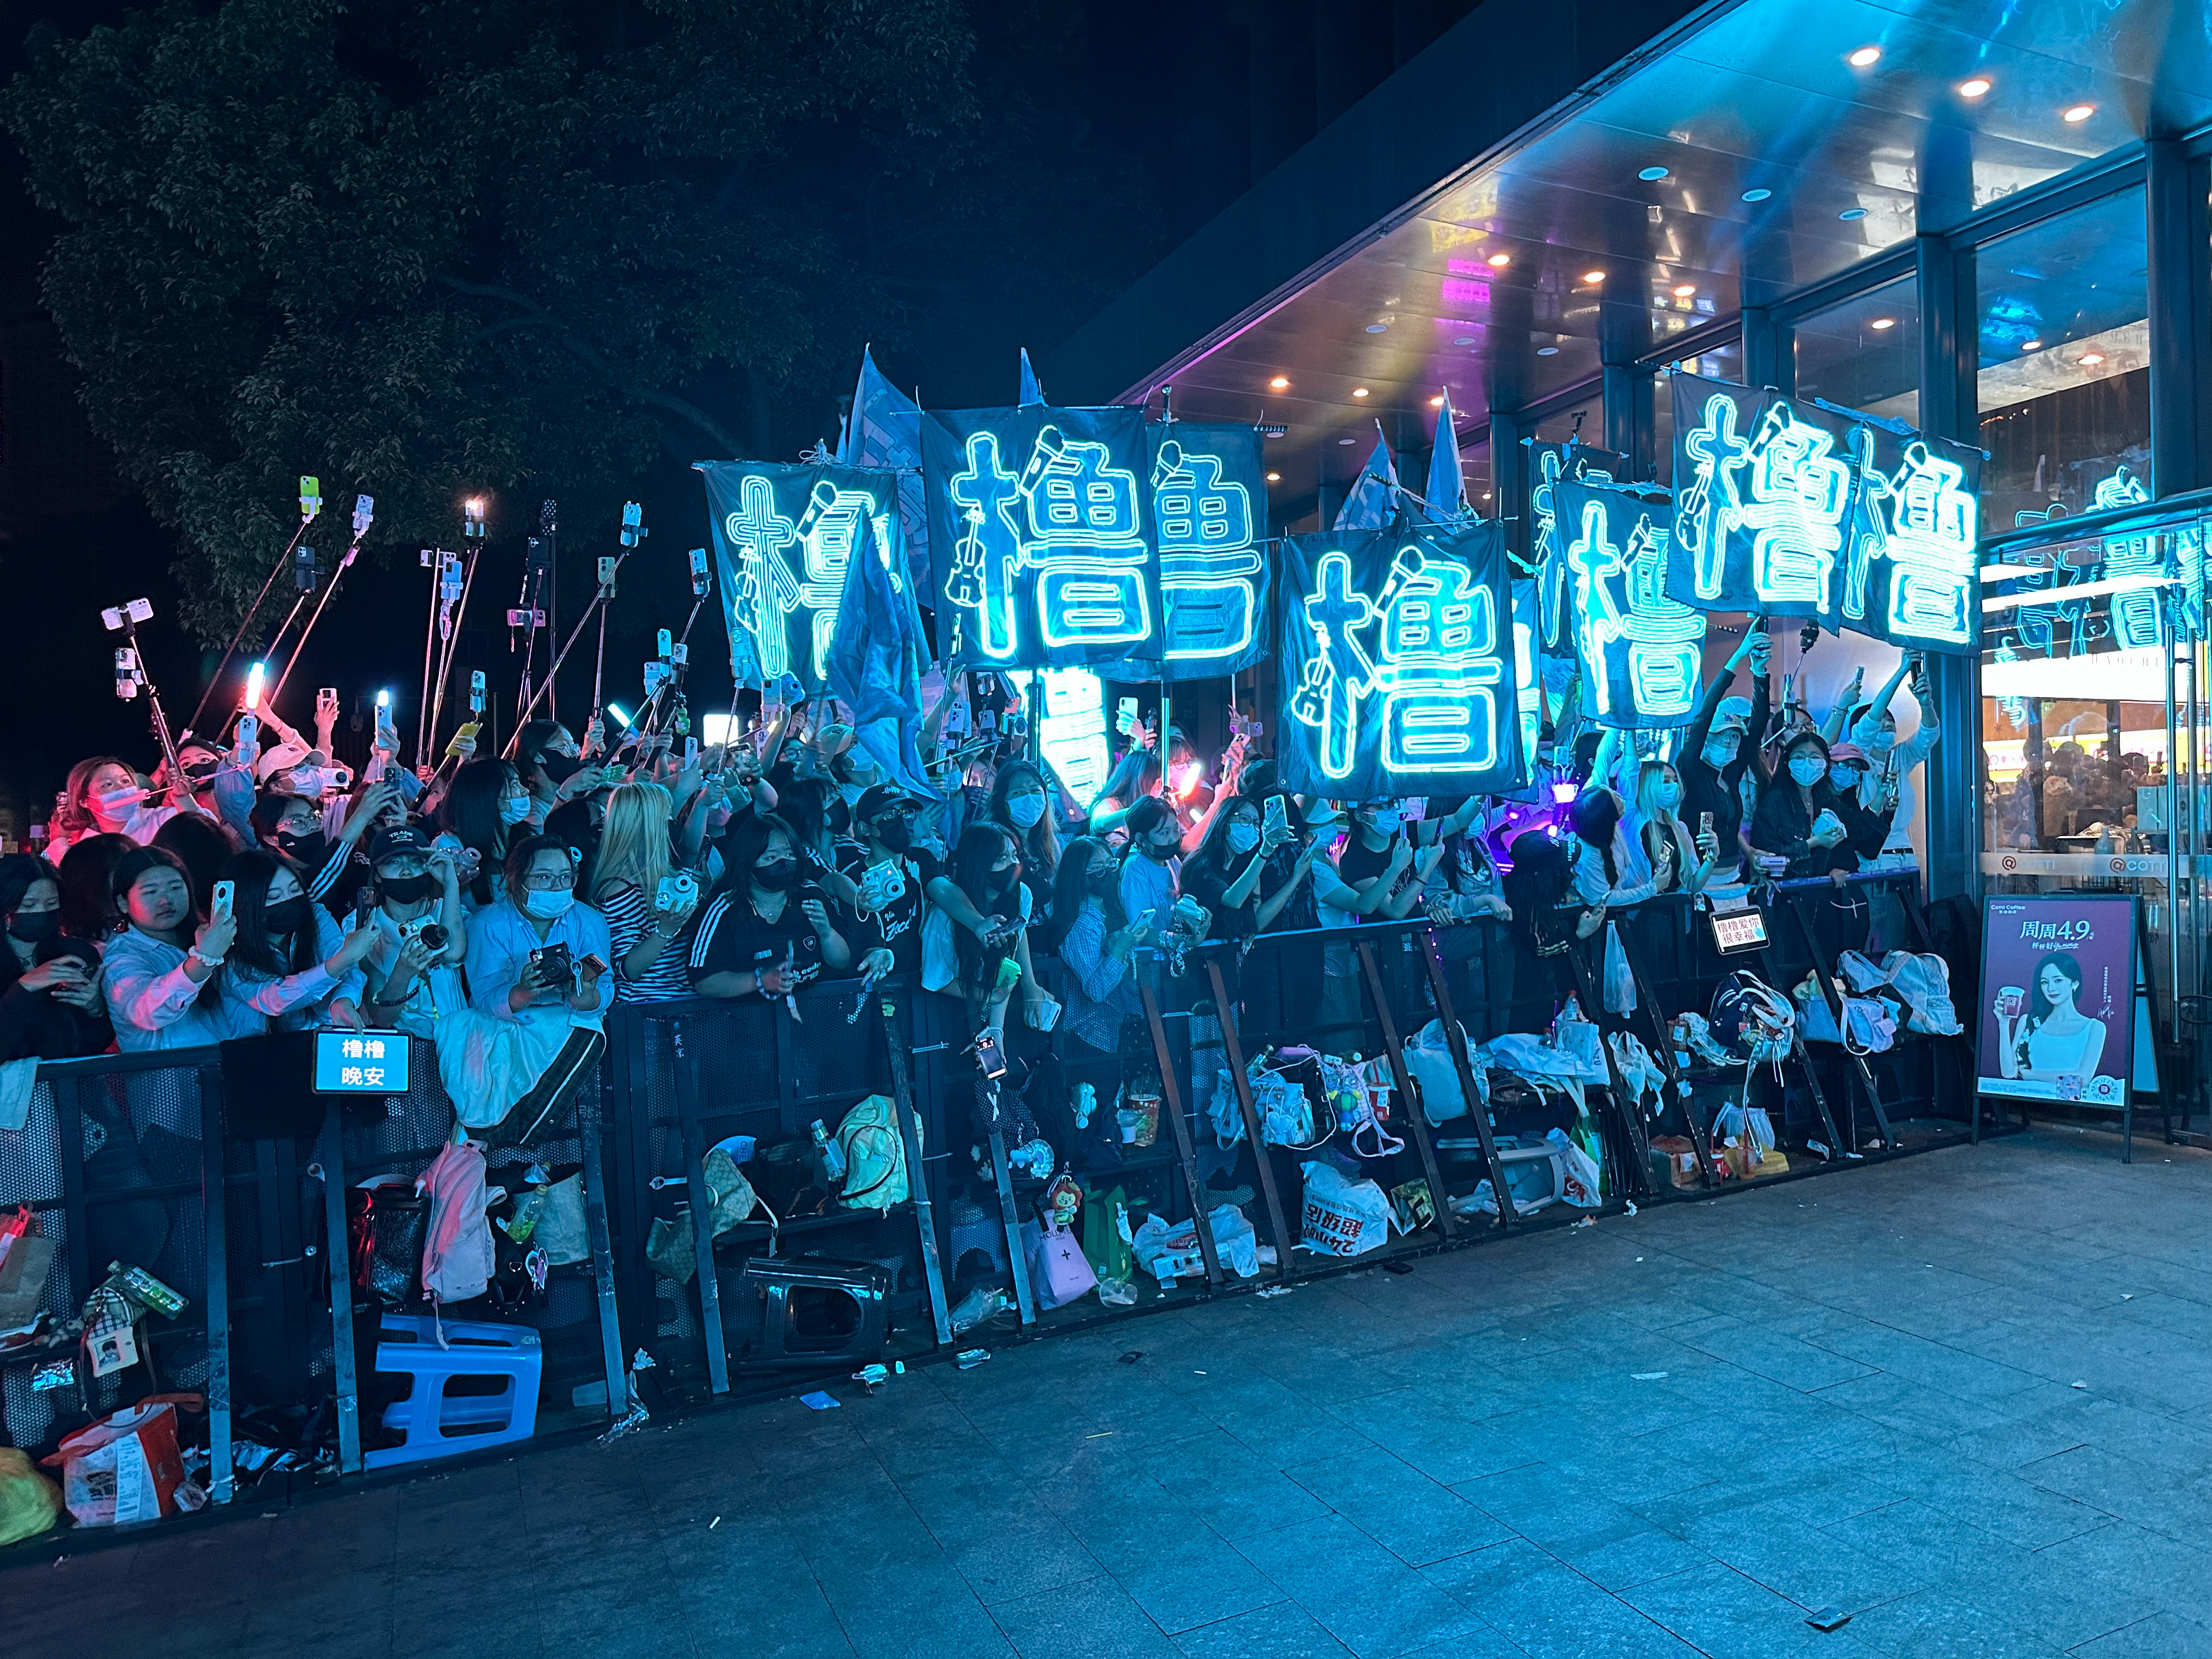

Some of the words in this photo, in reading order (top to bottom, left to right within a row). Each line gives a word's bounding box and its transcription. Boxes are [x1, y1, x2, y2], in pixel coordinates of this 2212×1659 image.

[1723, 929, 1755, 944] 很幸福
[341, 1066, 385, 1086] 晚安
[1306, 1203, 1364, 1238] 超级店
